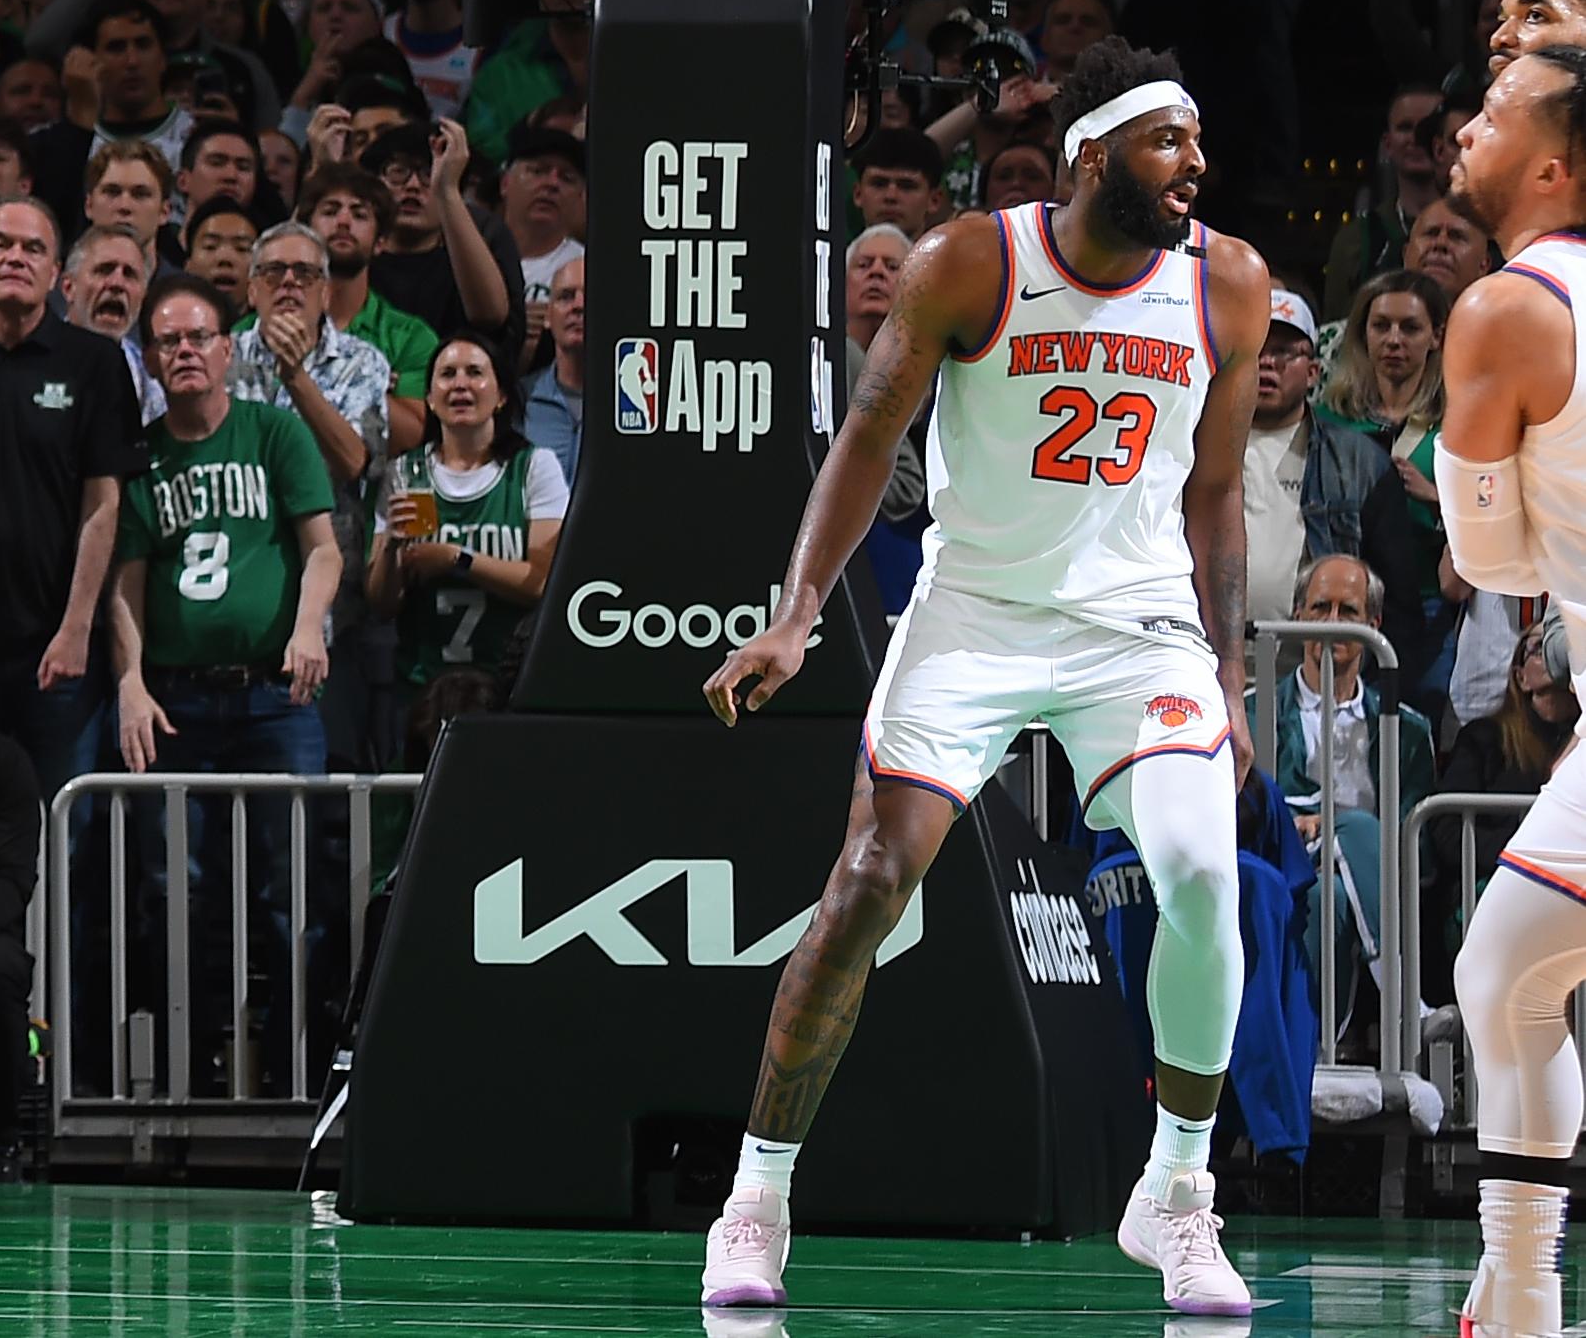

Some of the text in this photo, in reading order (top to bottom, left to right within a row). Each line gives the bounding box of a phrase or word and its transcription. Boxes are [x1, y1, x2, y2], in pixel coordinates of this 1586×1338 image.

[643, 140, 749, 231] GET
[641, 239, 749, 329] THE
[665, 339, 773, 452] App
[1008, 331, 1195, 387] NEW YORK
[1031, 385, 1157, 486] 23
[153, 462, 269, 538] BOSTON
[179, 532, 229, 600] 8
[436, 588, 486, 662] 7
[1011, 858, 1102, 985] coinbase
